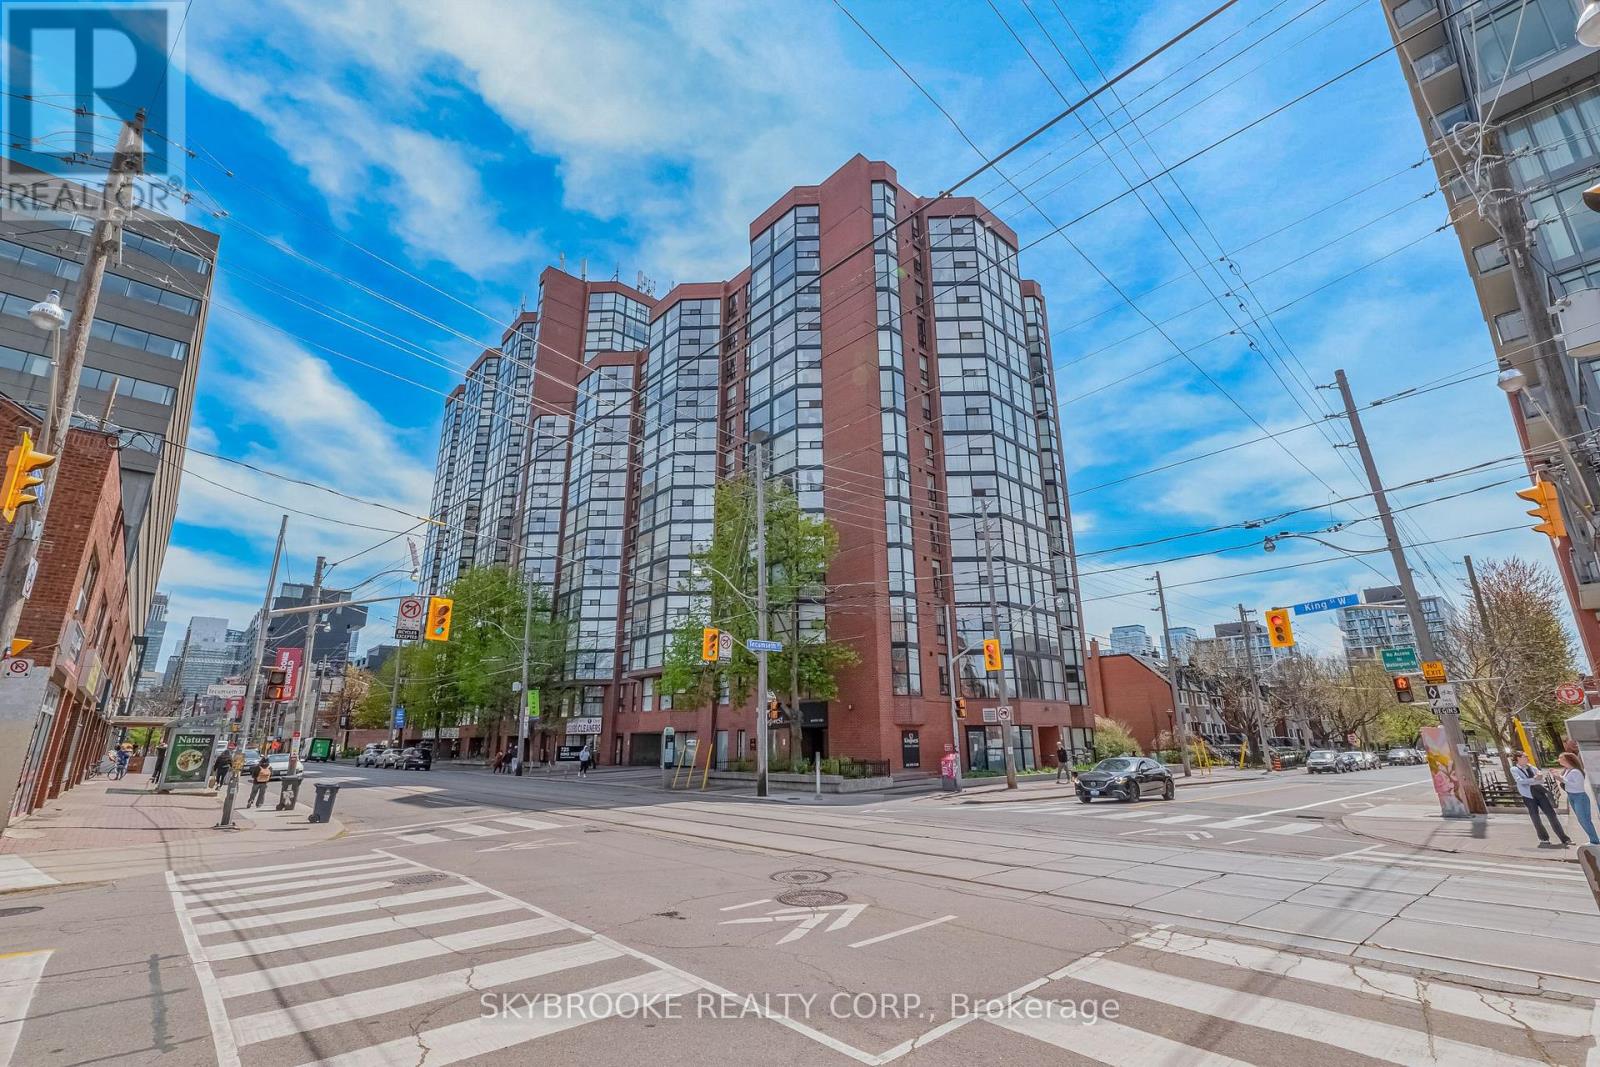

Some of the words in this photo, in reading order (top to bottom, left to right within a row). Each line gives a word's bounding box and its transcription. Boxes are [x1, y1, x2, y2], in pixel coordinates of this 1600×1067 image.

[1304, 602, 1328, 611] King
[1338, 597, 1346, 605] W
[285, 660, 294, 684] WORLD
